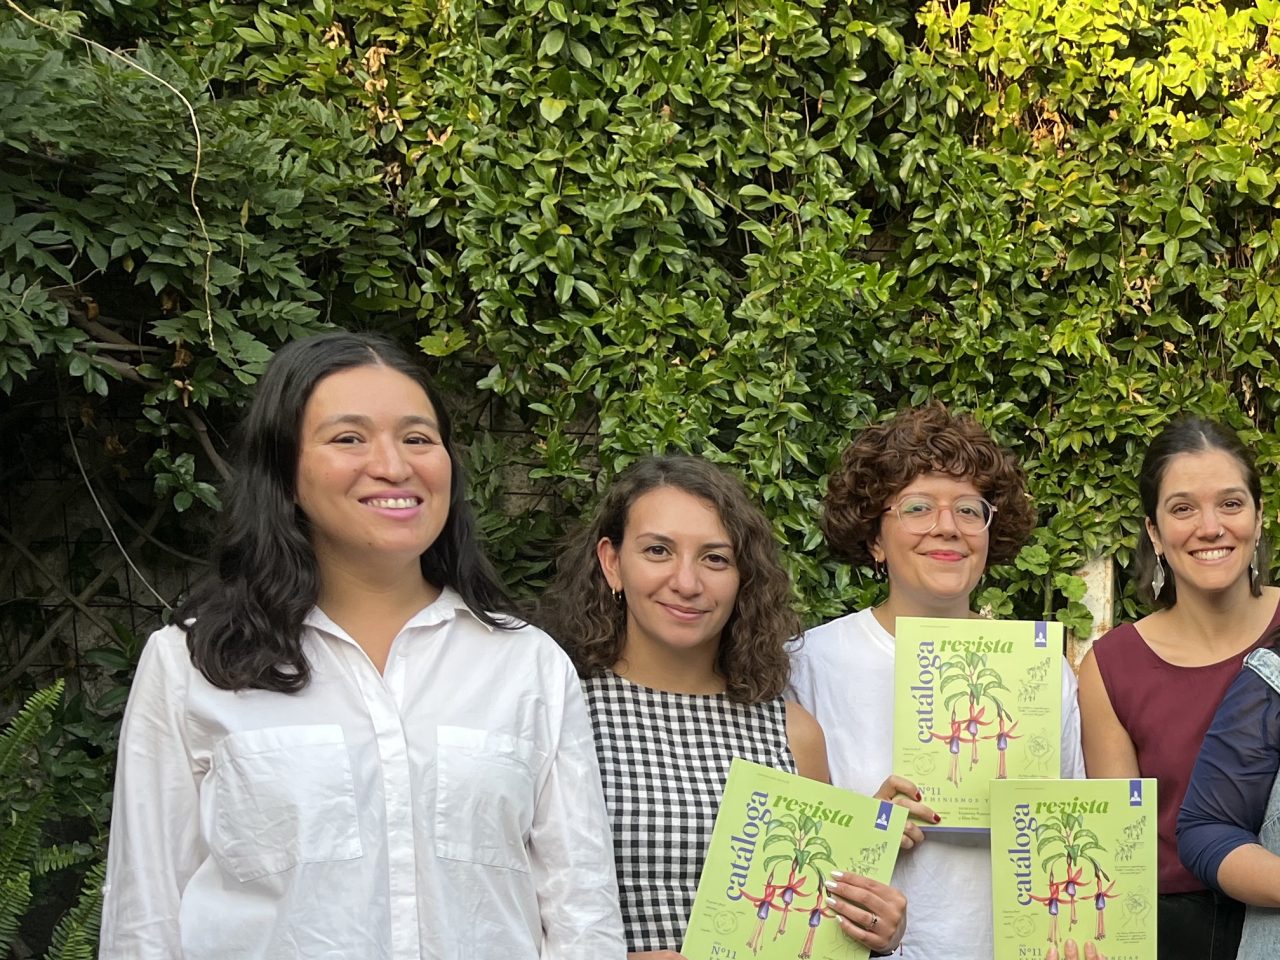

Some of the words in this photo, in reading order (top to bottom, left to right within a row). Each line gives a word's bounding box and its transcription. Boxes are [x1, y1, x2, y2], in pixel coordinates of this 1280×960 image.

[939, 636, 1014, 654] revista
[911, 641, 942, 743] catáloga
[773, 794, 854, 827] revista
[1035, 797, 1109, 814] revista
[726, 791, 772, 901] catáloga
[1008, 803, 1038, 906] catáloga
